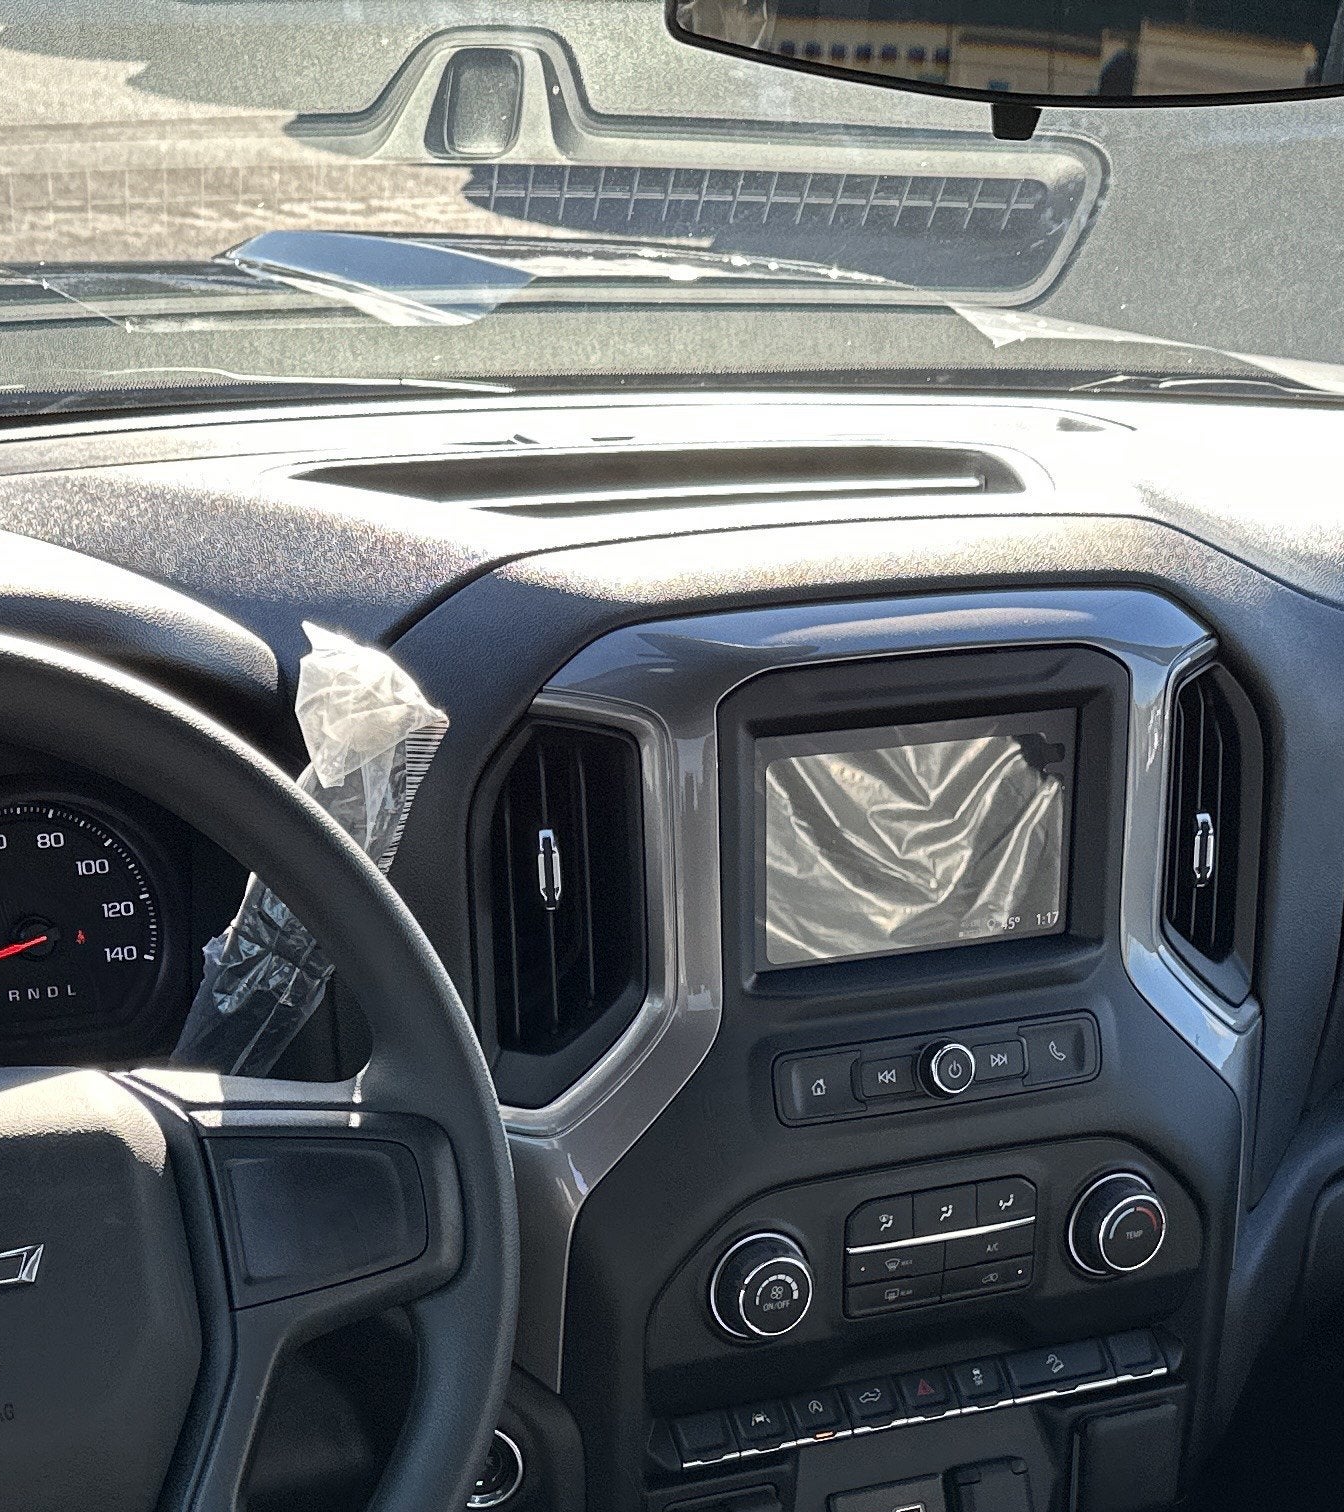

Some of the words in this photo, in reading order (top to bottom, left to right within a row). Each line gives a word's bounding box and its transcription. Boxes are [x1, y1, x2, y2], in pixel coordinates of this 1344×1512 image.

[37, 832, 64, 848] 80
[76, 859, 109, 875] 100
[102, 901, 134, 918] 120
[1037, 911, 1059, 925] 1:17
[104, 946, 137, 962] 140
[9, 990, 20, 1002] R
[28, 988, 40, 1000] N
[48, 986, 58, 998] D
[68, 985, 76, 996] L
[1125, 1229, 1143, 1240] TEMP
[986, 1242, 999, 1252] A/C
[763, 1300, 790, 1311] ON/OFF
